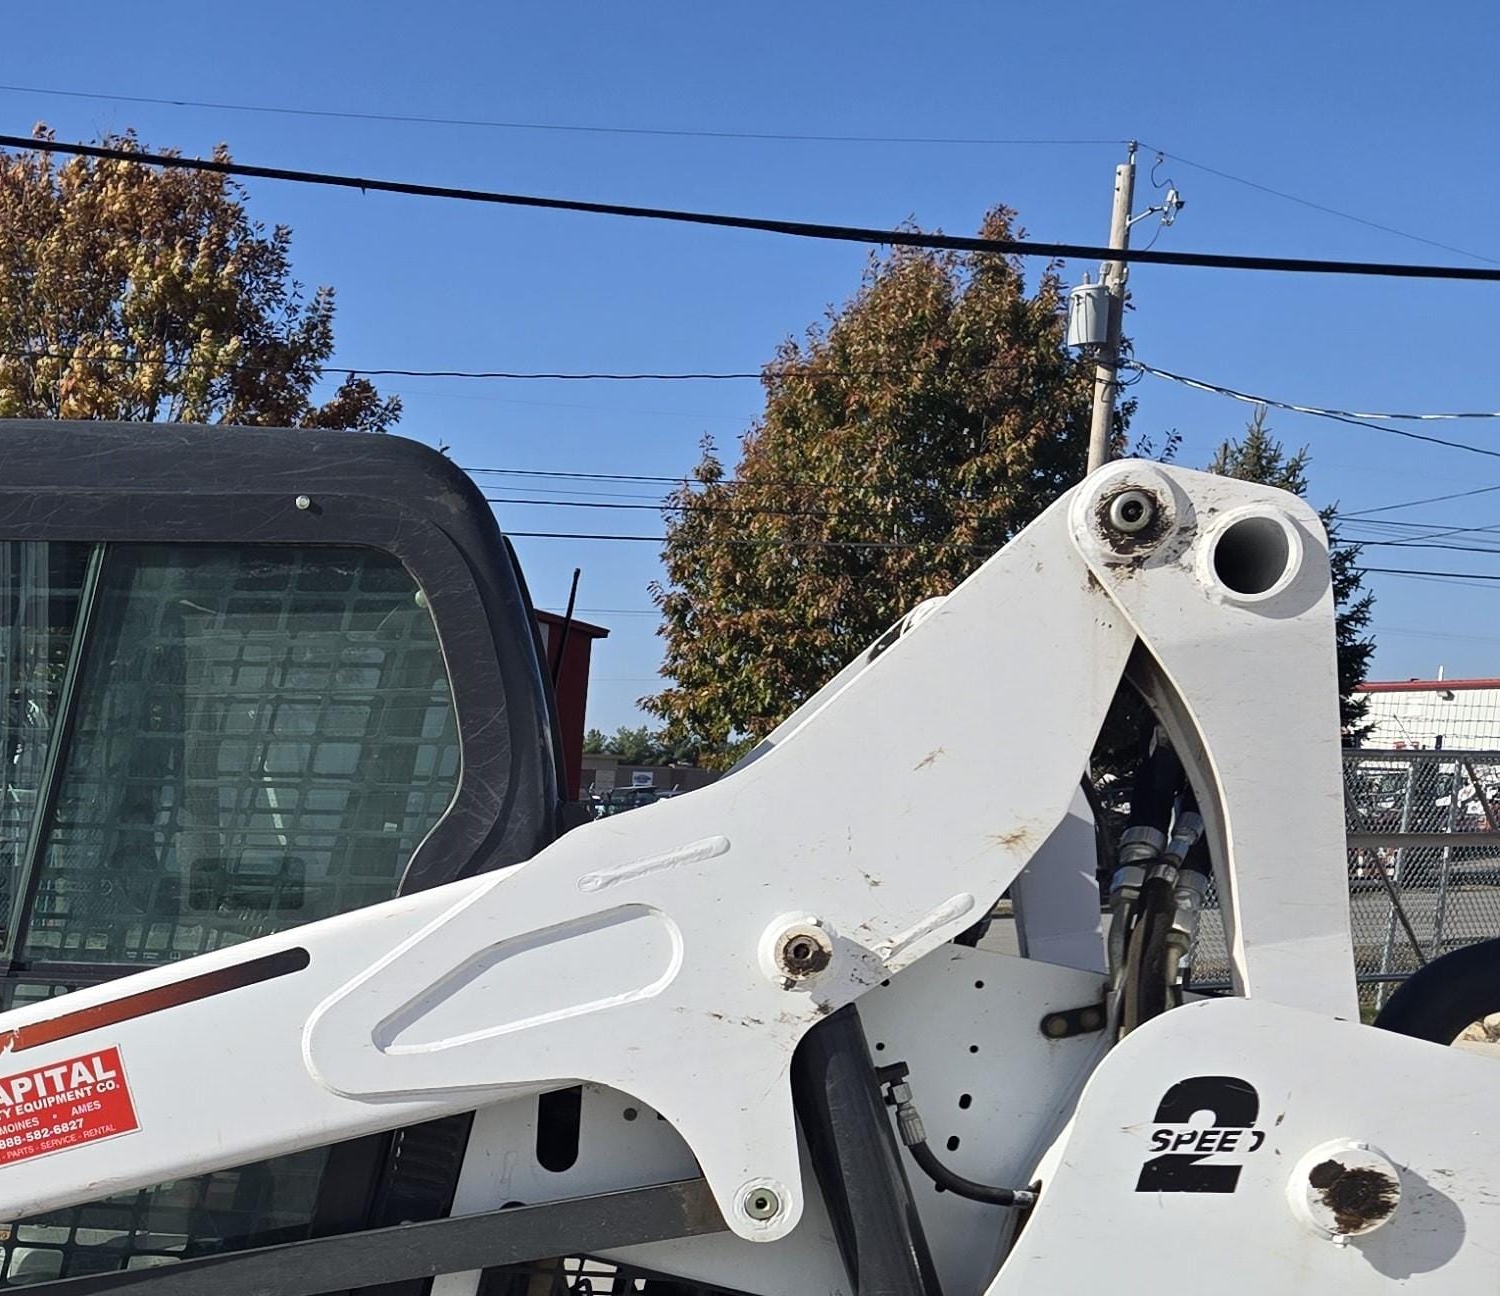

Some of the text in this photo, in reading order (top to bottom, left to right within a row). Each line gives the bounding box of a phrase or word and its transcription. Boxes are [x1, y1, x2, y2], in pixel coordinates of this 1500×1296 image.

[16, 1087, 92, 1116] EQUIPMENT
[96, 1080, 120, 1093] CO.
[0, 1117, 40, 1137] MOINES
[71, 1100, 101, 1117] AMES
[6, 1145, 34, 1159] PARTS
[40, 1134, 77, 1151] SERVICE
[83, 1124, 116, 1139] RENTAL
